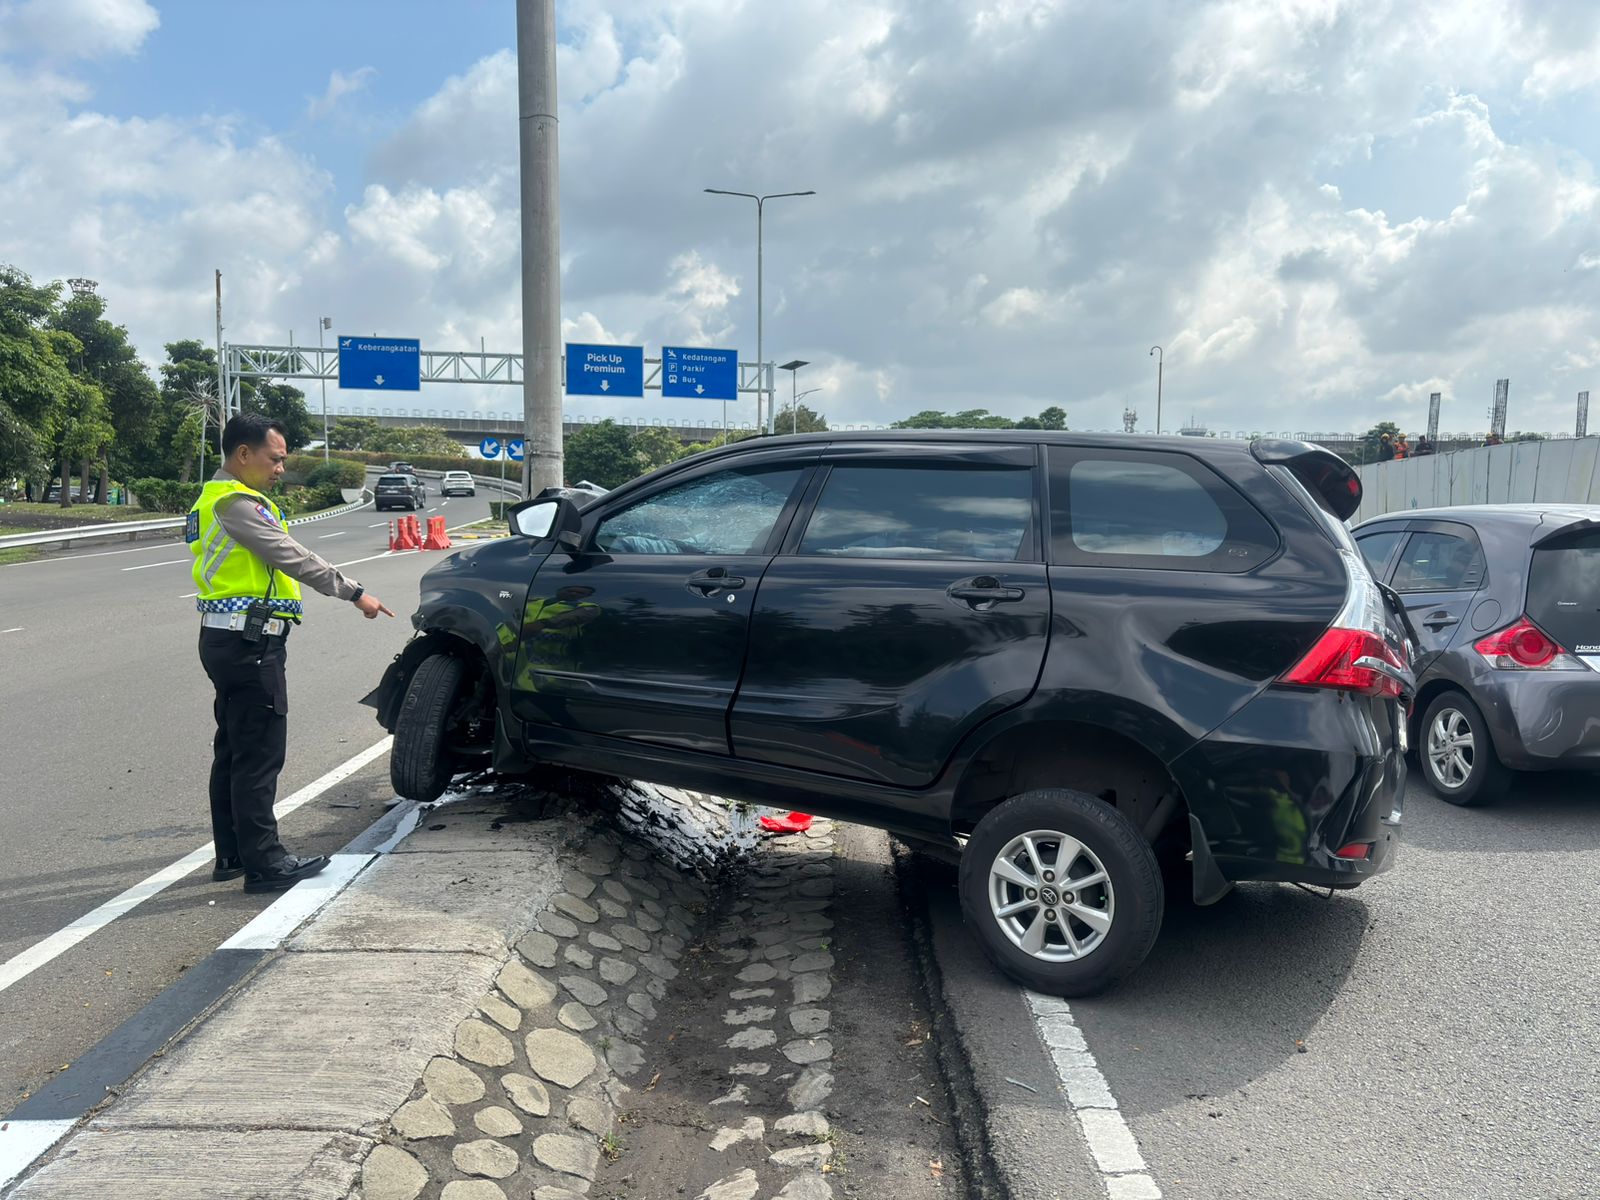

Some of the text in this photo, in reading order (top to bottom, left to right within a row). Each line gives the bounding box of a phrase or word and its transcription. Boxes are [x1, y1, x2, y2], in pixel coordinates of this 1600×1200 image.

[358, 343, 417, 353] Keberangkatan
[587, 353, 622, 364] Pick Up
[682, 354, 727, 364] Kedatangan
[584, 363, 626, 373] Premium
